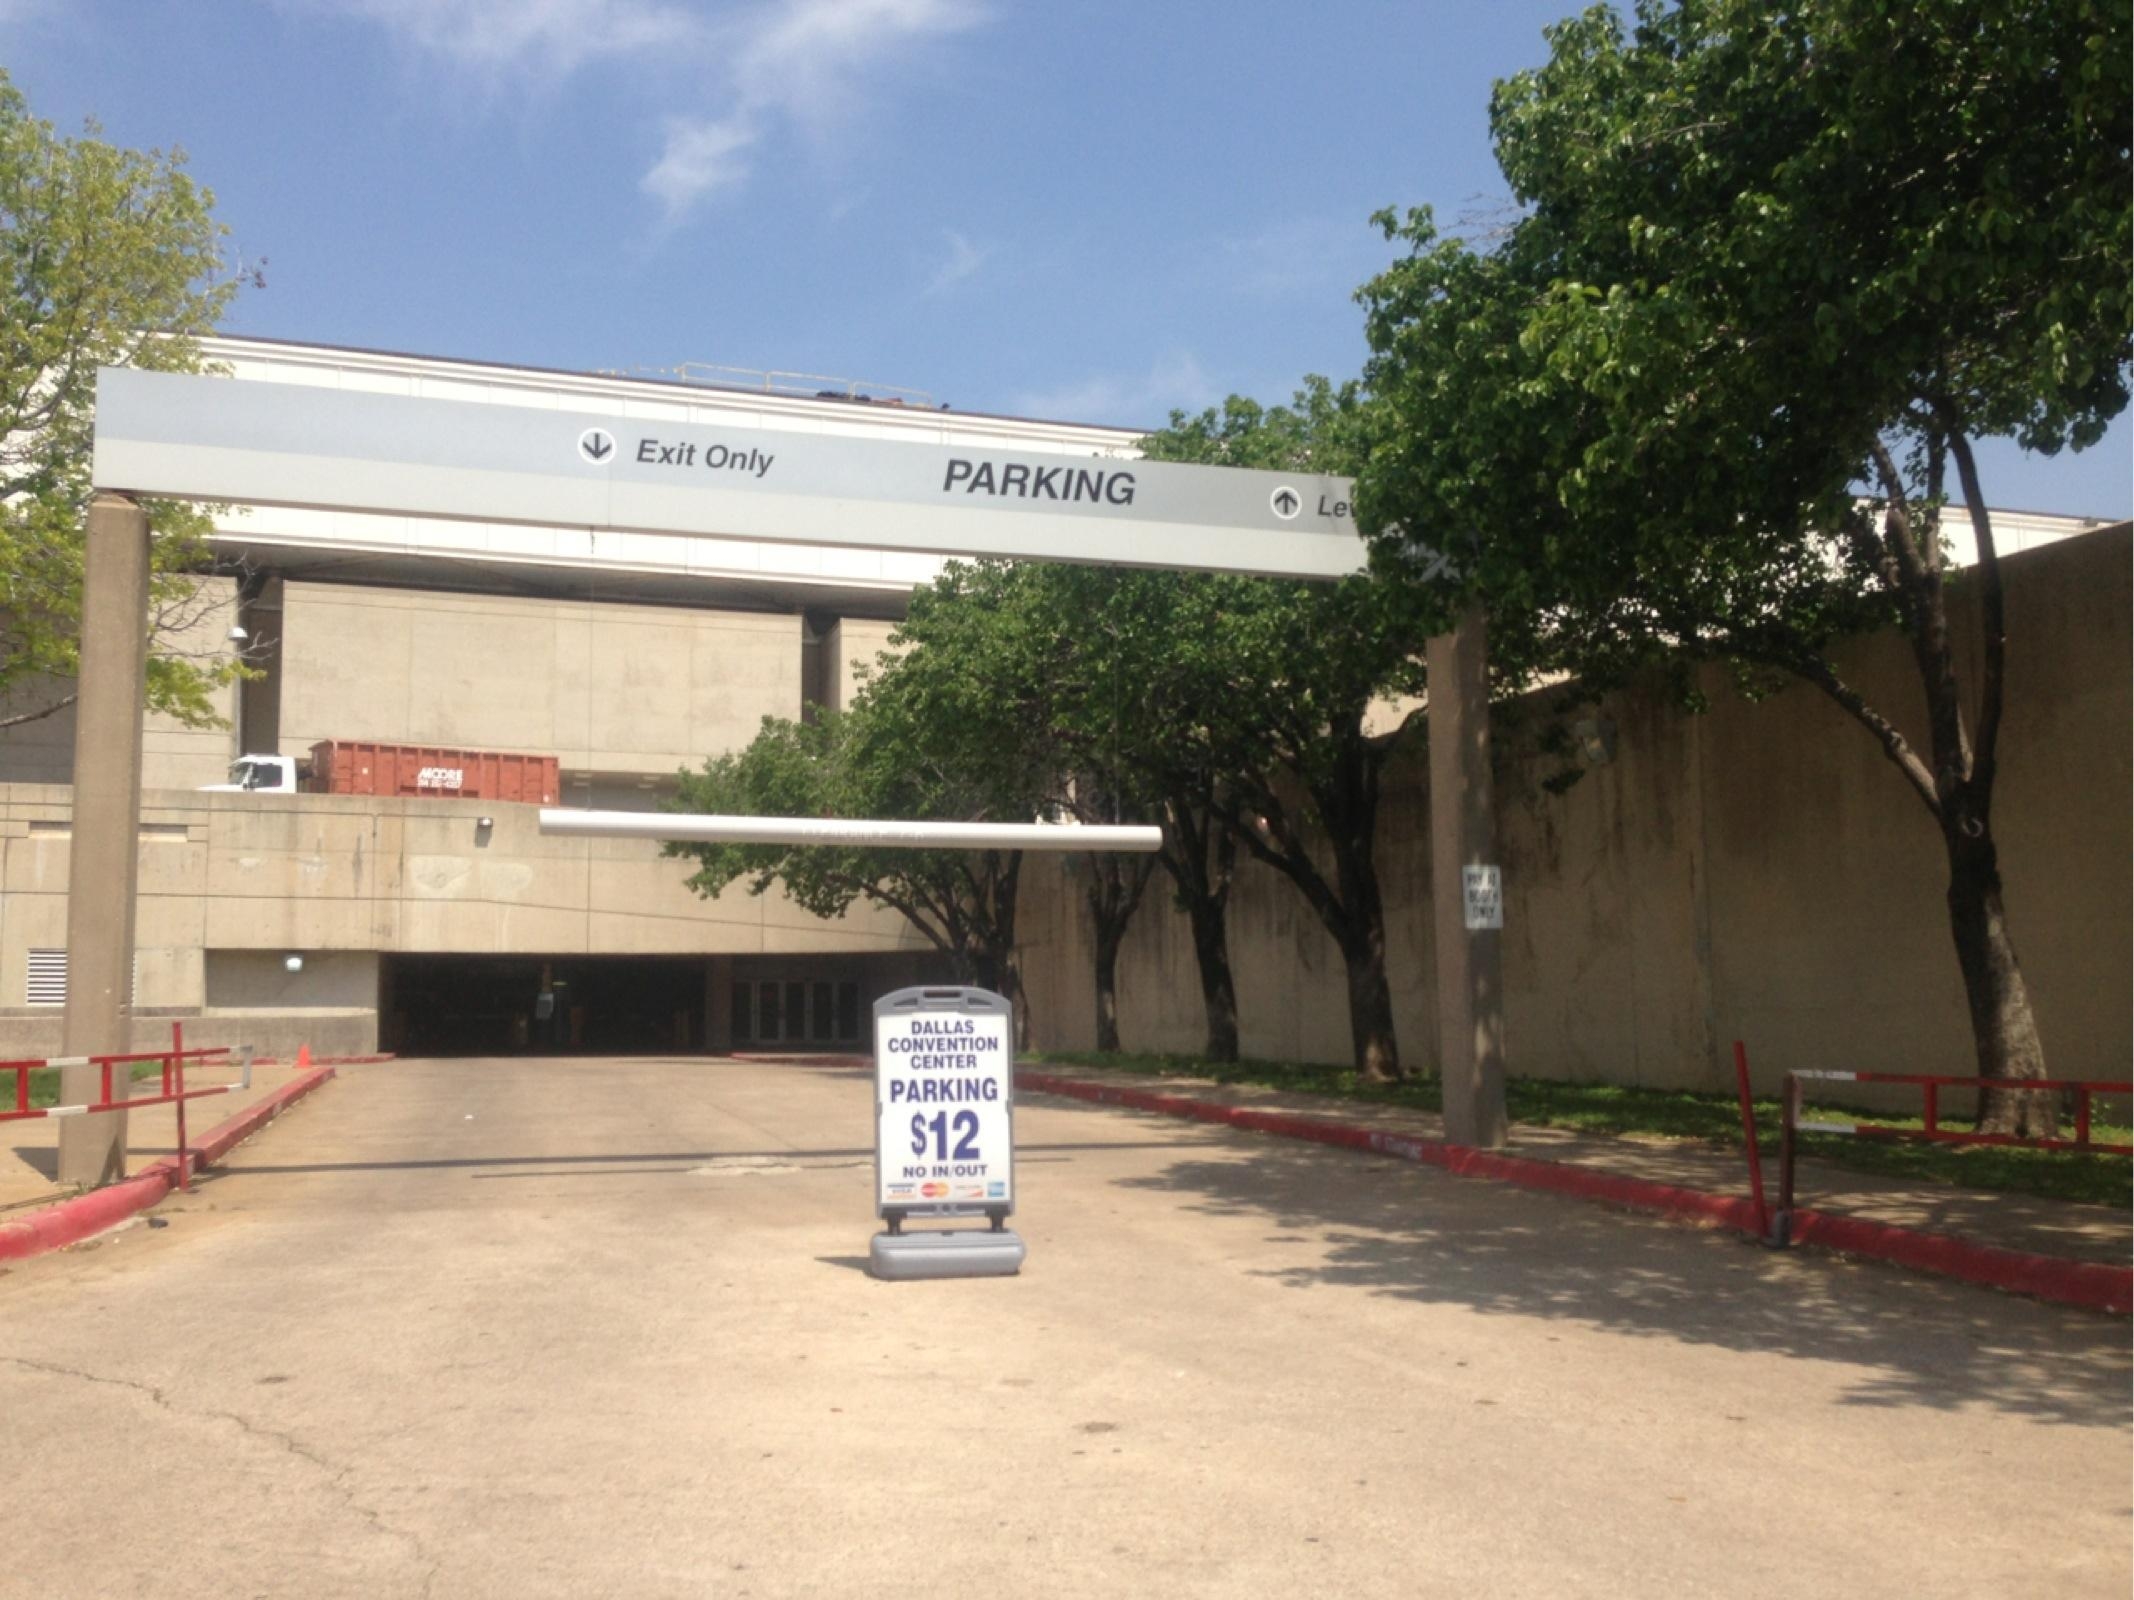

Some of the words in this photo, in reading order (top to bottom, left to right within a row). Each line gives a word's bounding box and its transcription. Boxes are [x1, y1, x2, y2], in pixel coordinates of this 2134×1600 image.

[636, 438, 697, 467] Exit
[705, 444, 775, 478] Only
[943, 459, 1136, 505] PARKING
[418, 767, 463, 780] MOORE
[911, 1020, 974, 1034] DALLAS
[887, 1037, 998, 1053] CONVENTION
[910, 1055, 977, 1069] CENTER
[890, 1078, 998, 1103] PARKING
[911, 1109, 980, 1160] $12
[903, 1166, 926, 1178] NO
